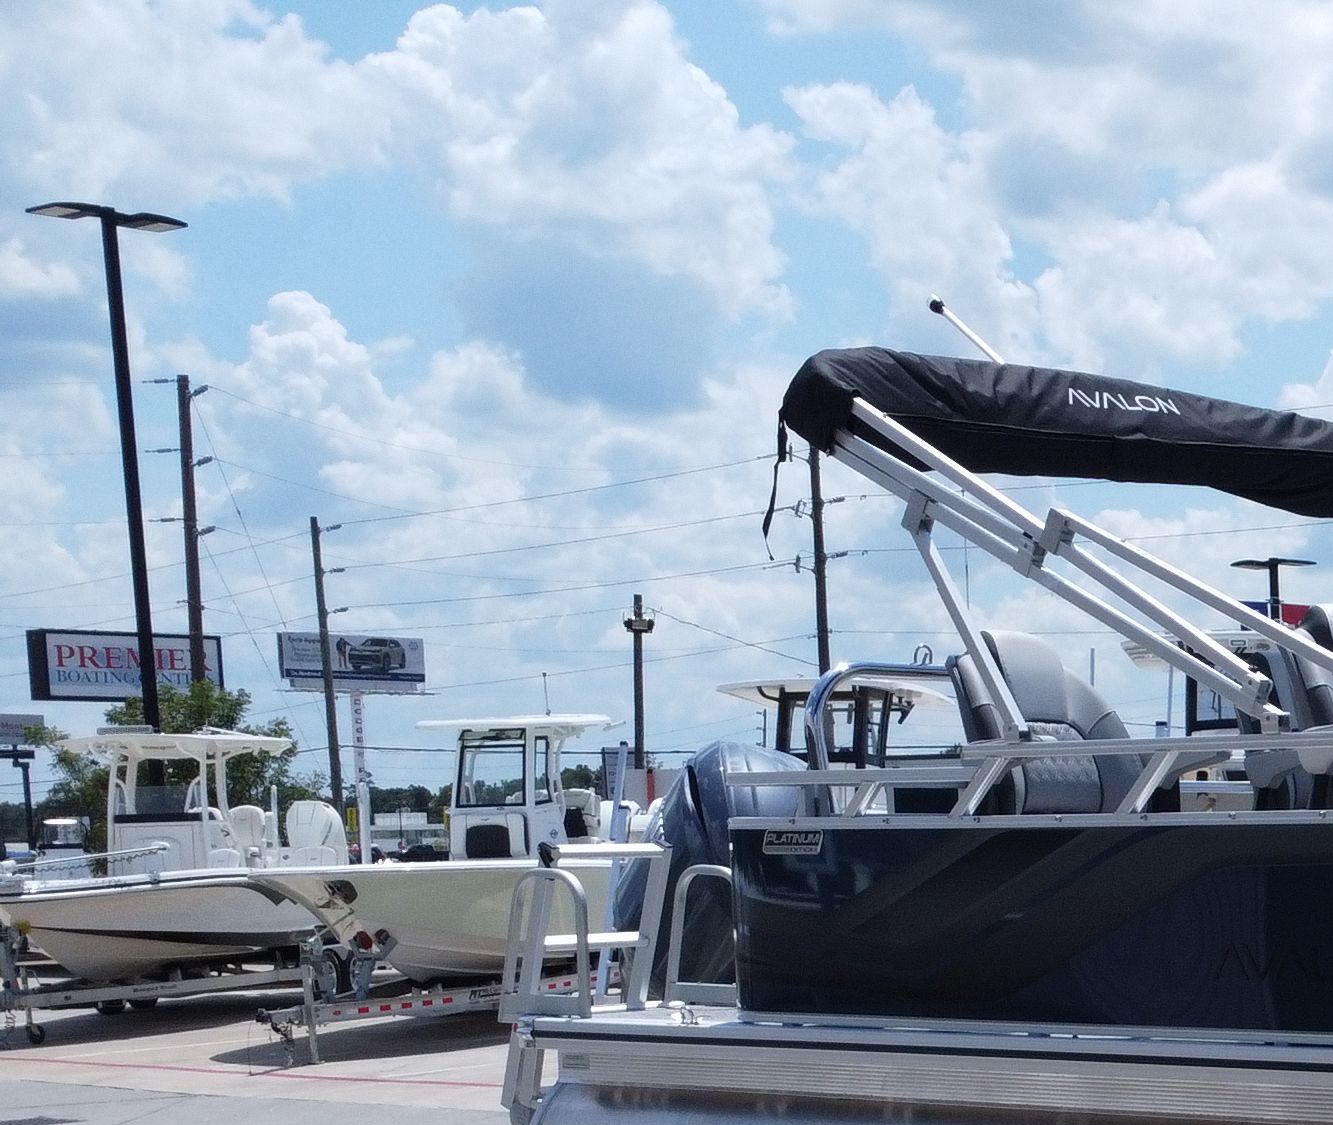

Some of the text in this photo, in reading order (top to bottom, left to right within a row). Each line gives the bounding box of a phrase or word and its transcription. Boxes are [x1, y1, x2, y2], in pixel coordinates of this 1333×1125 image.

[1069, 388, 1181, 415] AVALON
[57, 670, 135, 684] BOATING
[767, 833, 819, 843] PLATINUM
